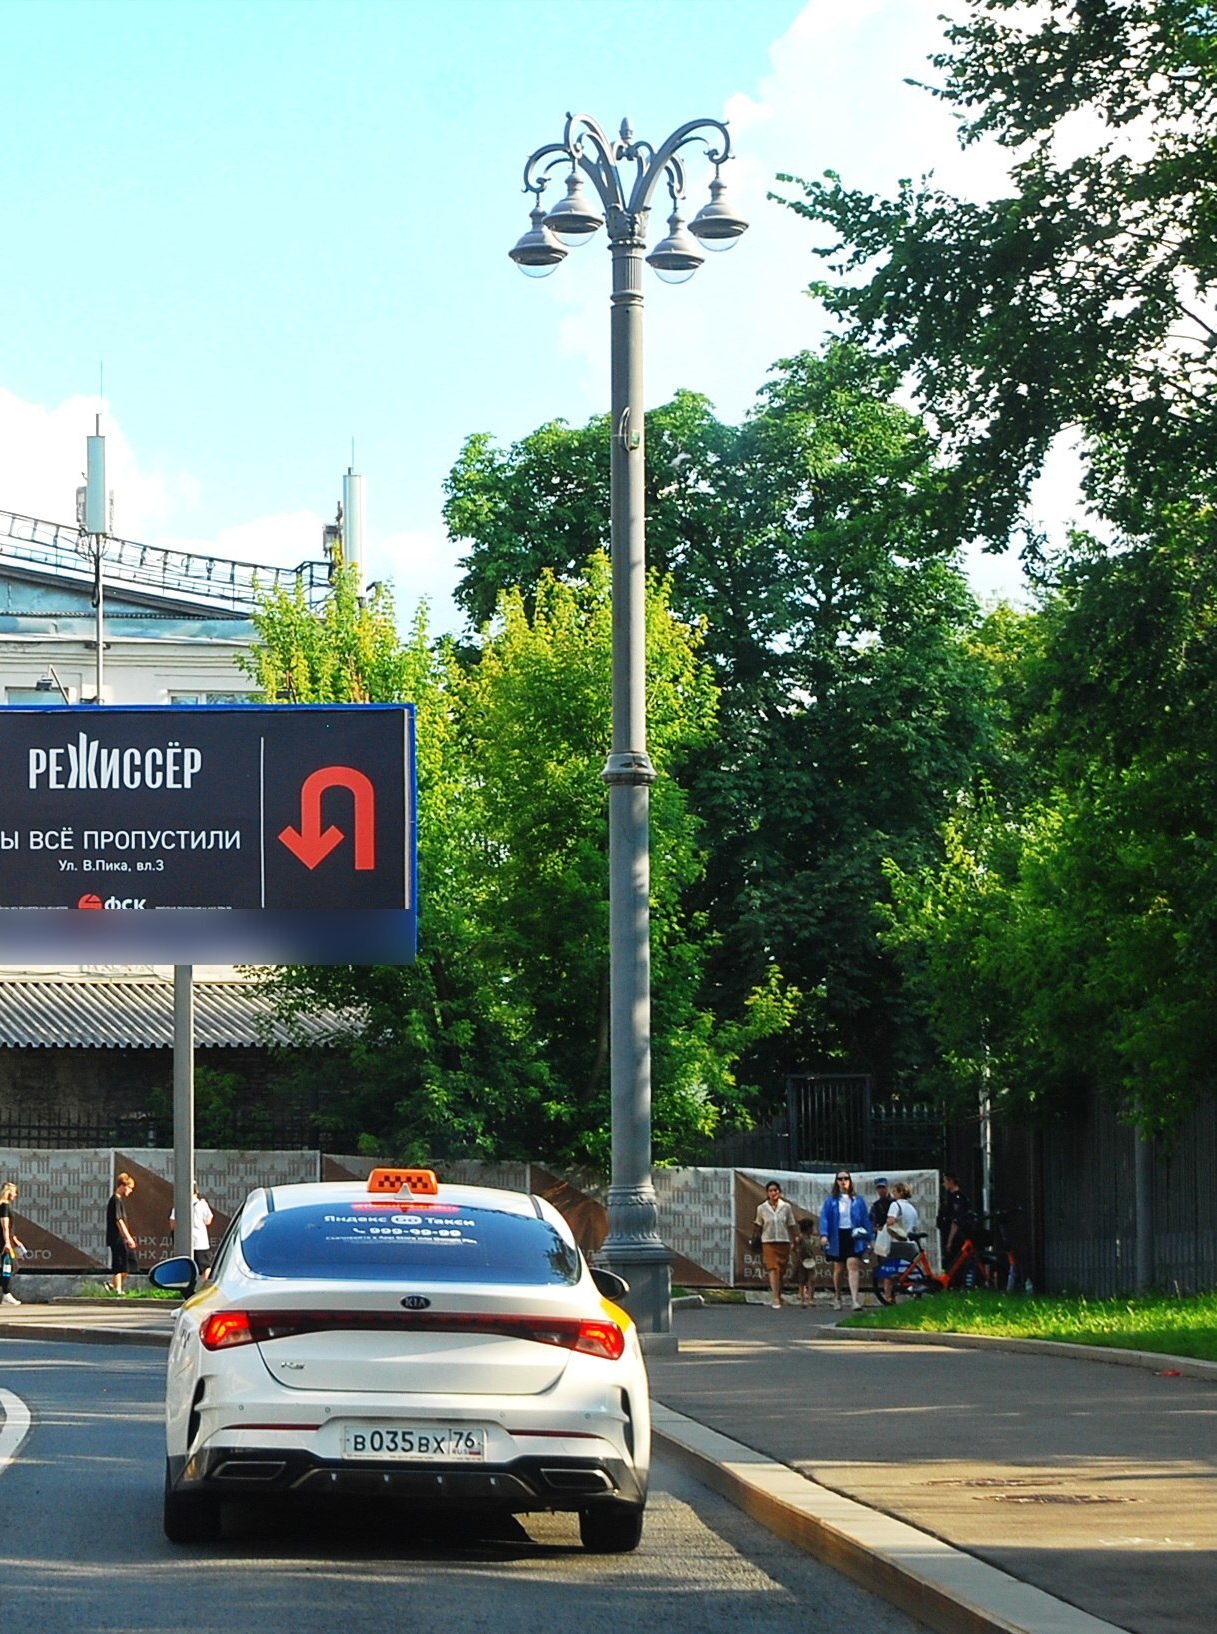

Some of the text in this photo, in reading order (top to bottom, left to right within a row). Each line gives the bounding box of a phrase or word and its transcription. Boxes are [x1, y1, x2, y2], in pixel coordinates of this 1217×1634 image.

[29, 731, 202, 789] РЕЖИССЁР
[30, 827, 74, 850] ВСЁ
[84, 831, 241, 850] ПРОПУСТИЛИ
[58, 860, 78, 873] Ул.
[137, 860, 164, 872] вл.3
[324, 1215, 387, 1223] Яндекс
[425, 1217, 475, 1227] Такси
[405, 1298, 427, 1307] KIA
[453, 1431, 476, 1449] 76
